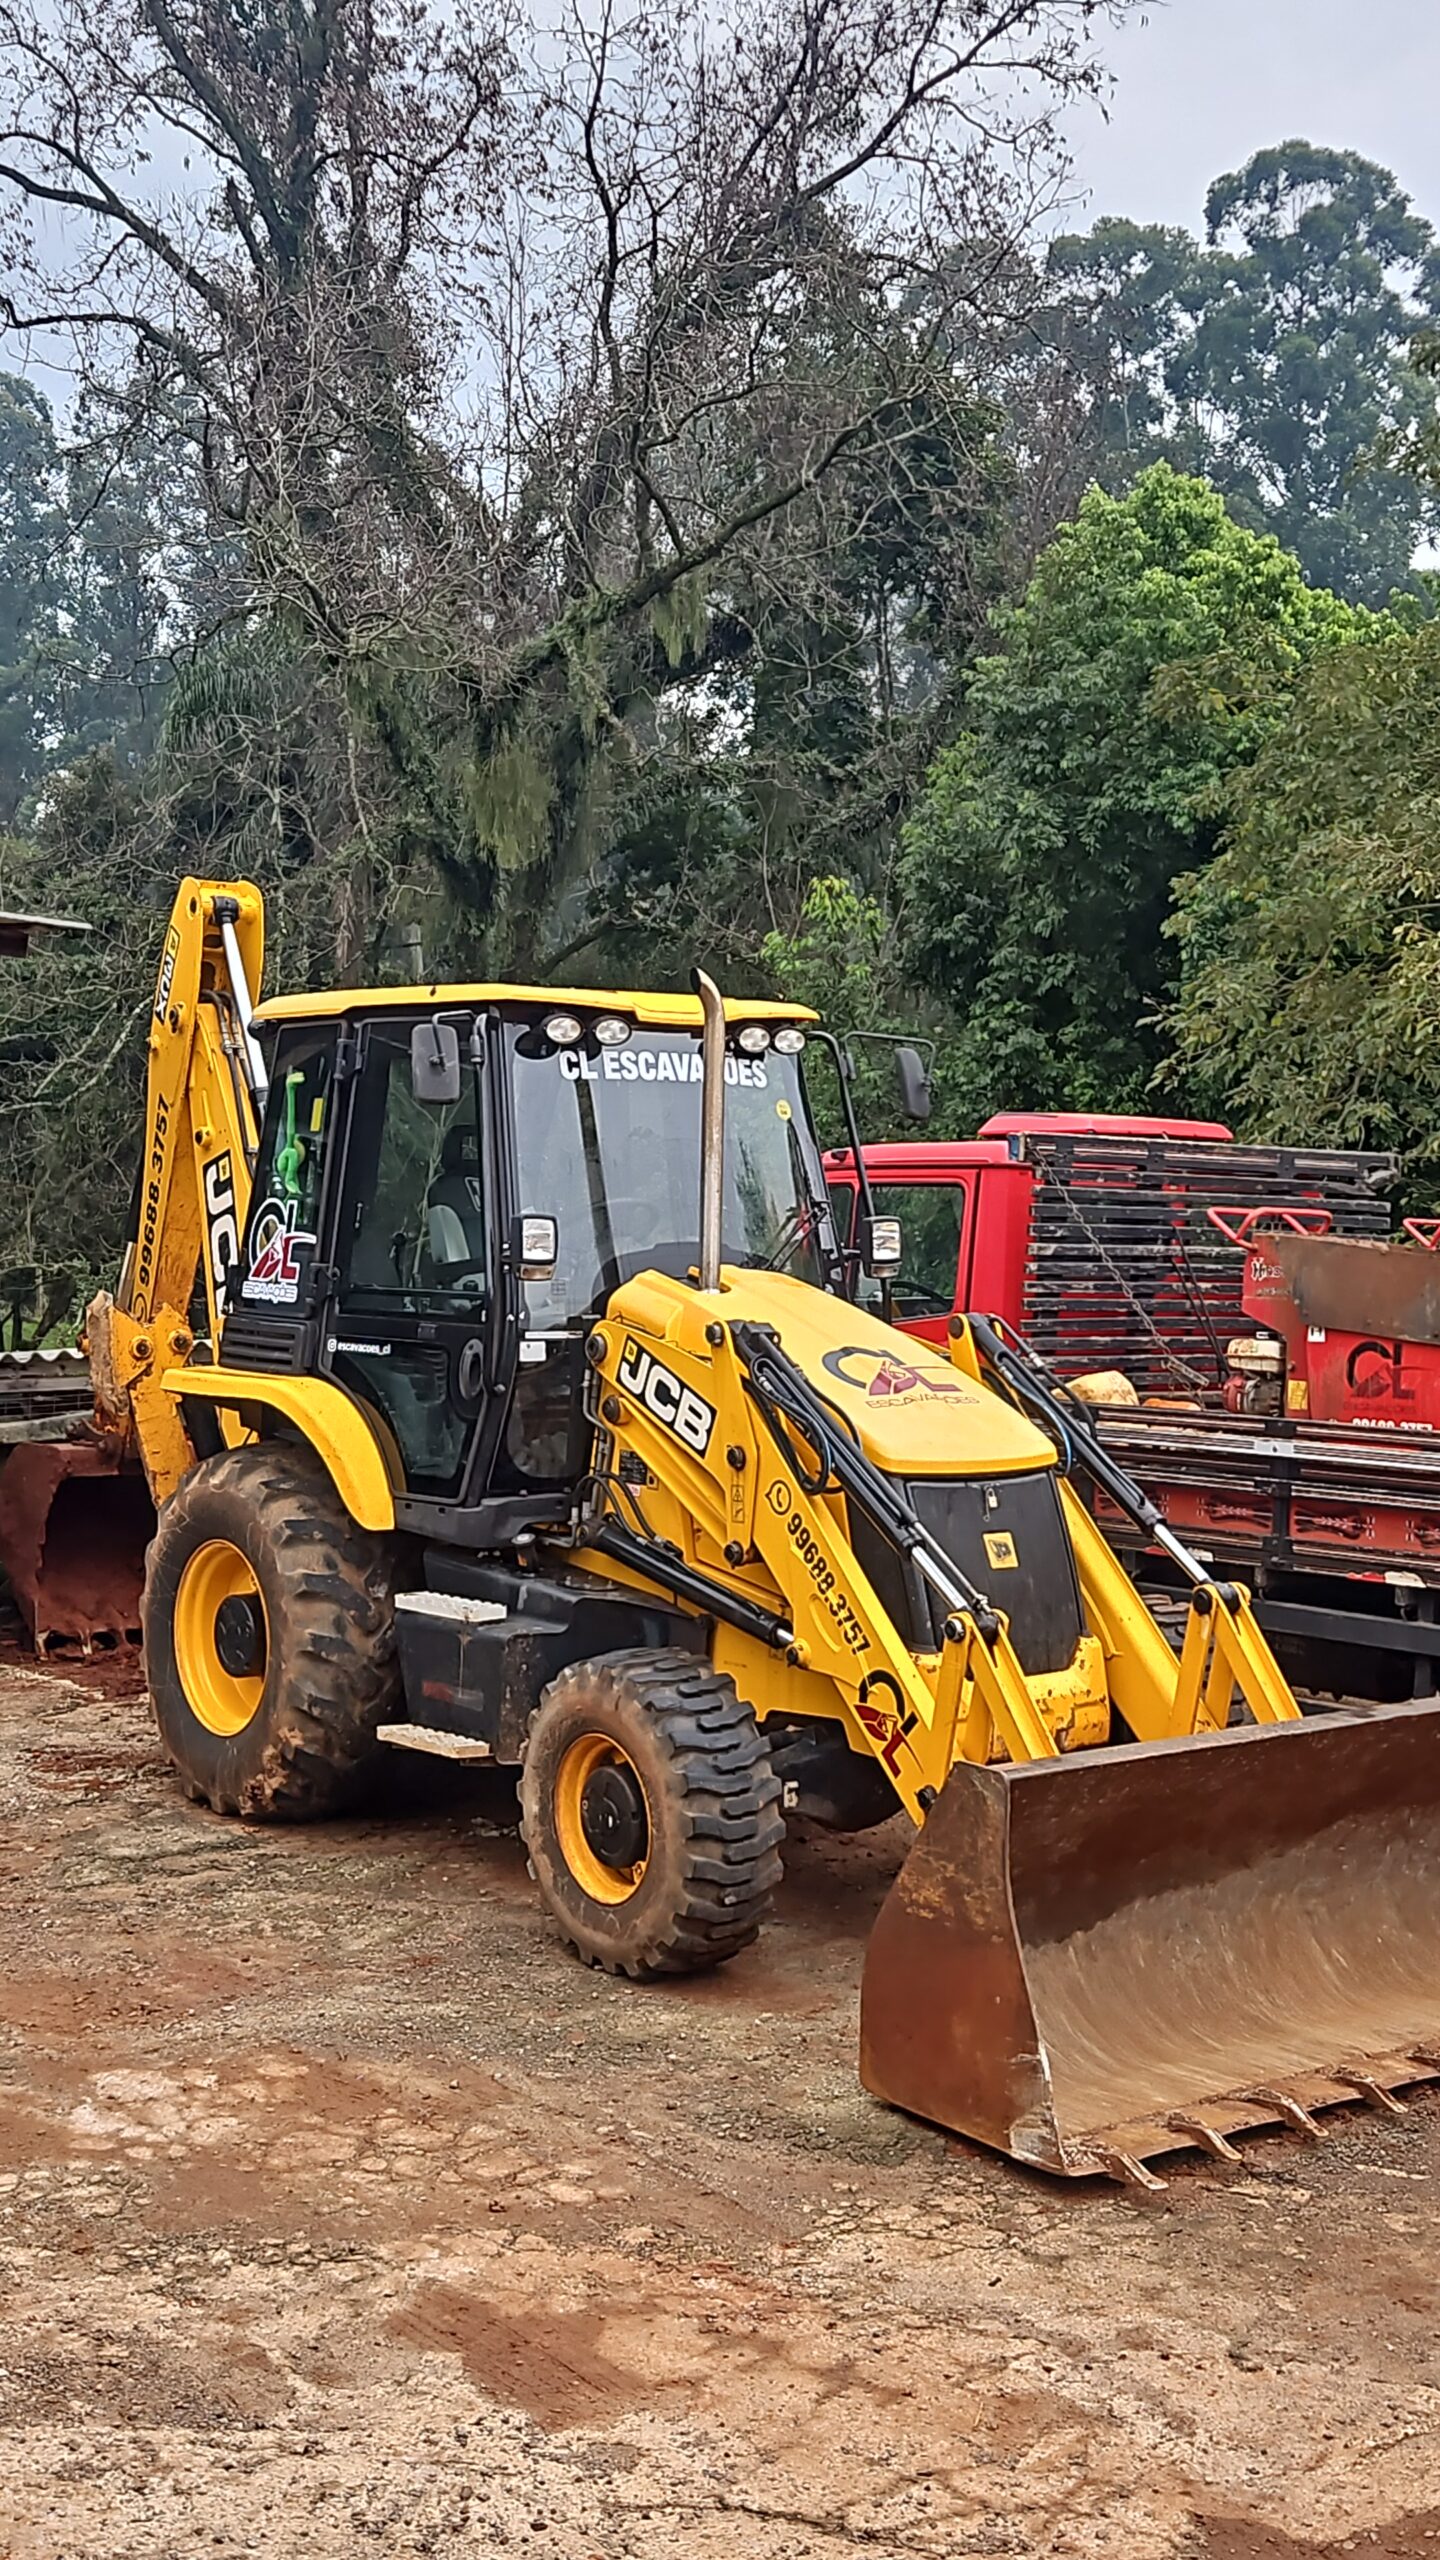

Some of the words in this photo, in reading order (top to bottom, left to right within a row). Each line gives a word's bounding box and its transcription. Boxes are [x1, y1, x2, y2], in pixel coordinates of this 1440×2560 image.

[559, 1050, 598, 1080] CL
[602, 1050, 768, 1089] ESCAVAÕES
[139, 1093, 170, 1287] 99688.3757
[619, 1352, 712, 1450] JCB
[787, 1513, 871, 1655] 99688.3757
